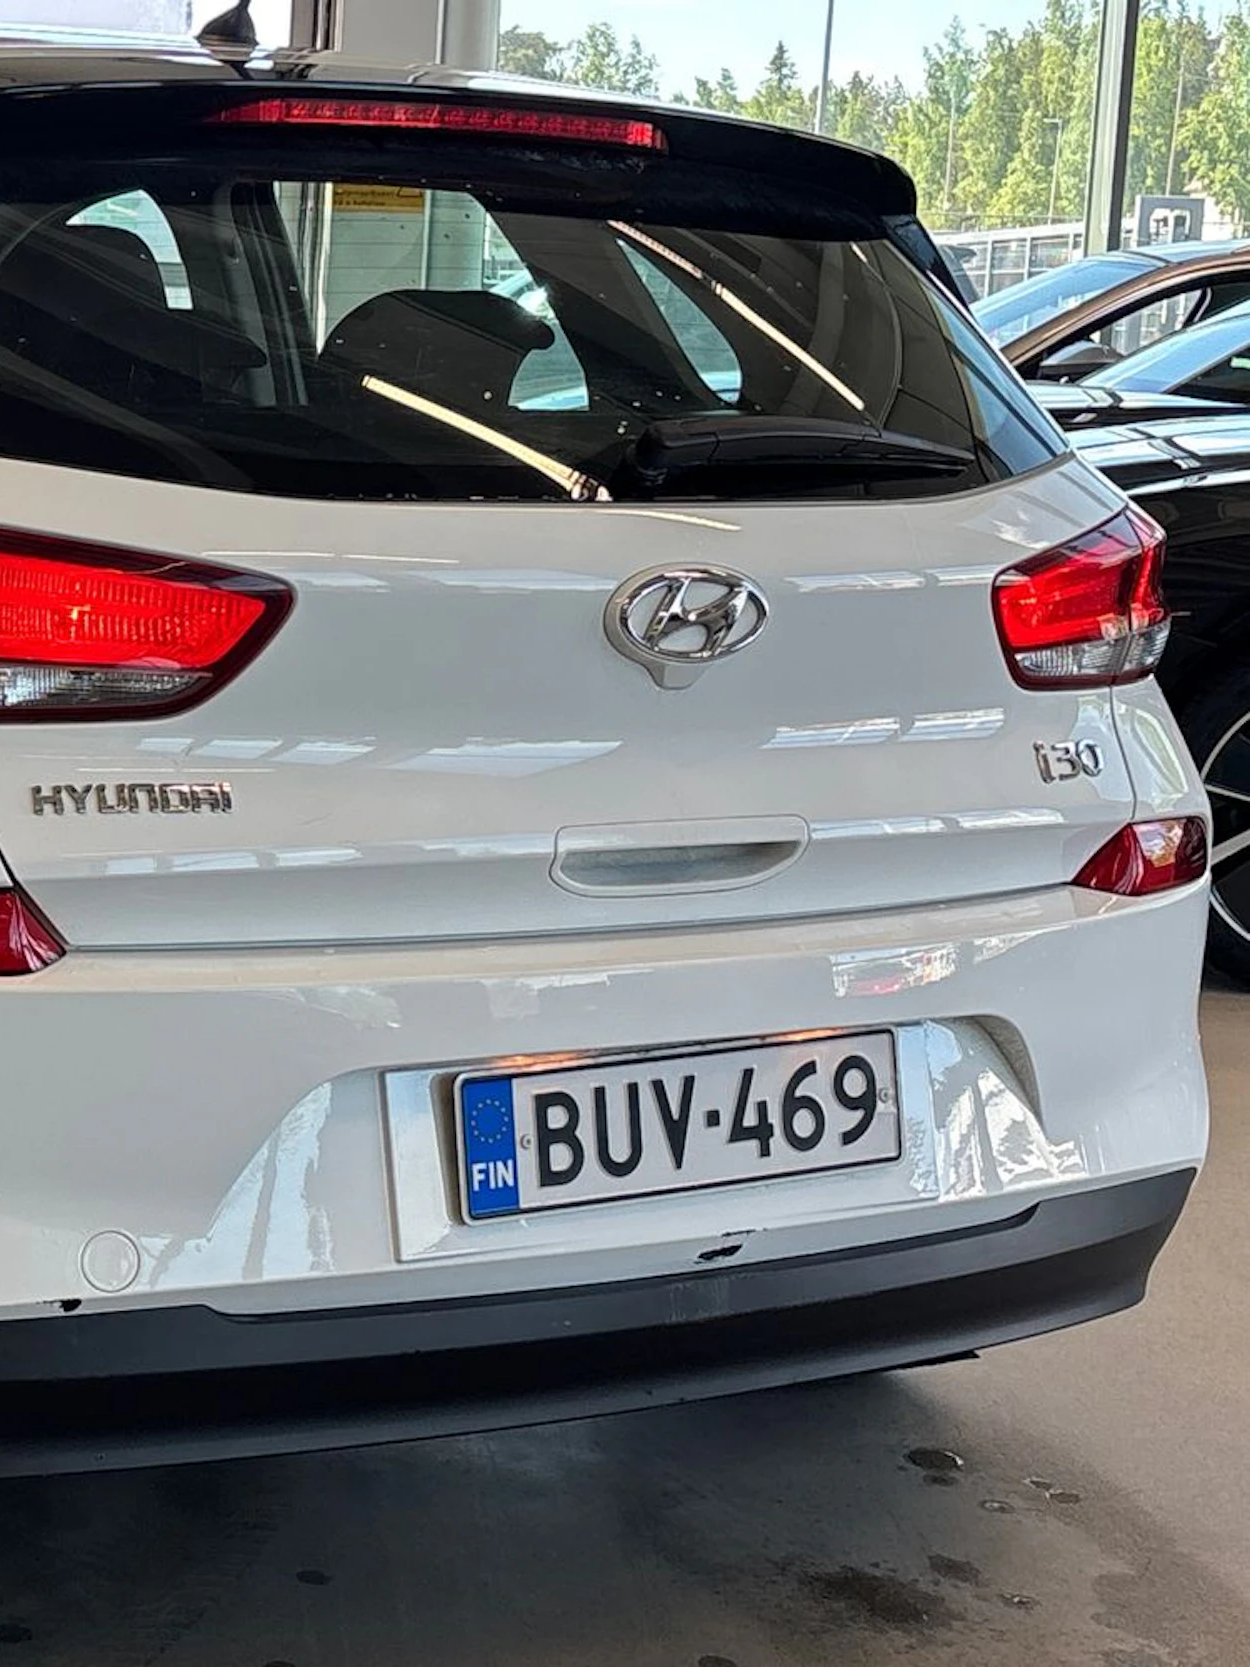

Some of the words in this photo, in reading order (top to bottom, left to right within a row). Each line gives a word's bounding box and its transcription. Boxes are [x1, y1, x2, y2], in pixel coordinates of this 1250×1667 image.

[1032, 739, 1105, 785] i30
[31, 782, 233, 816] HYUNDAI
[532, 1055, 878, 1188] BUV-469
[471, 1159, 515, 1192] FIN
